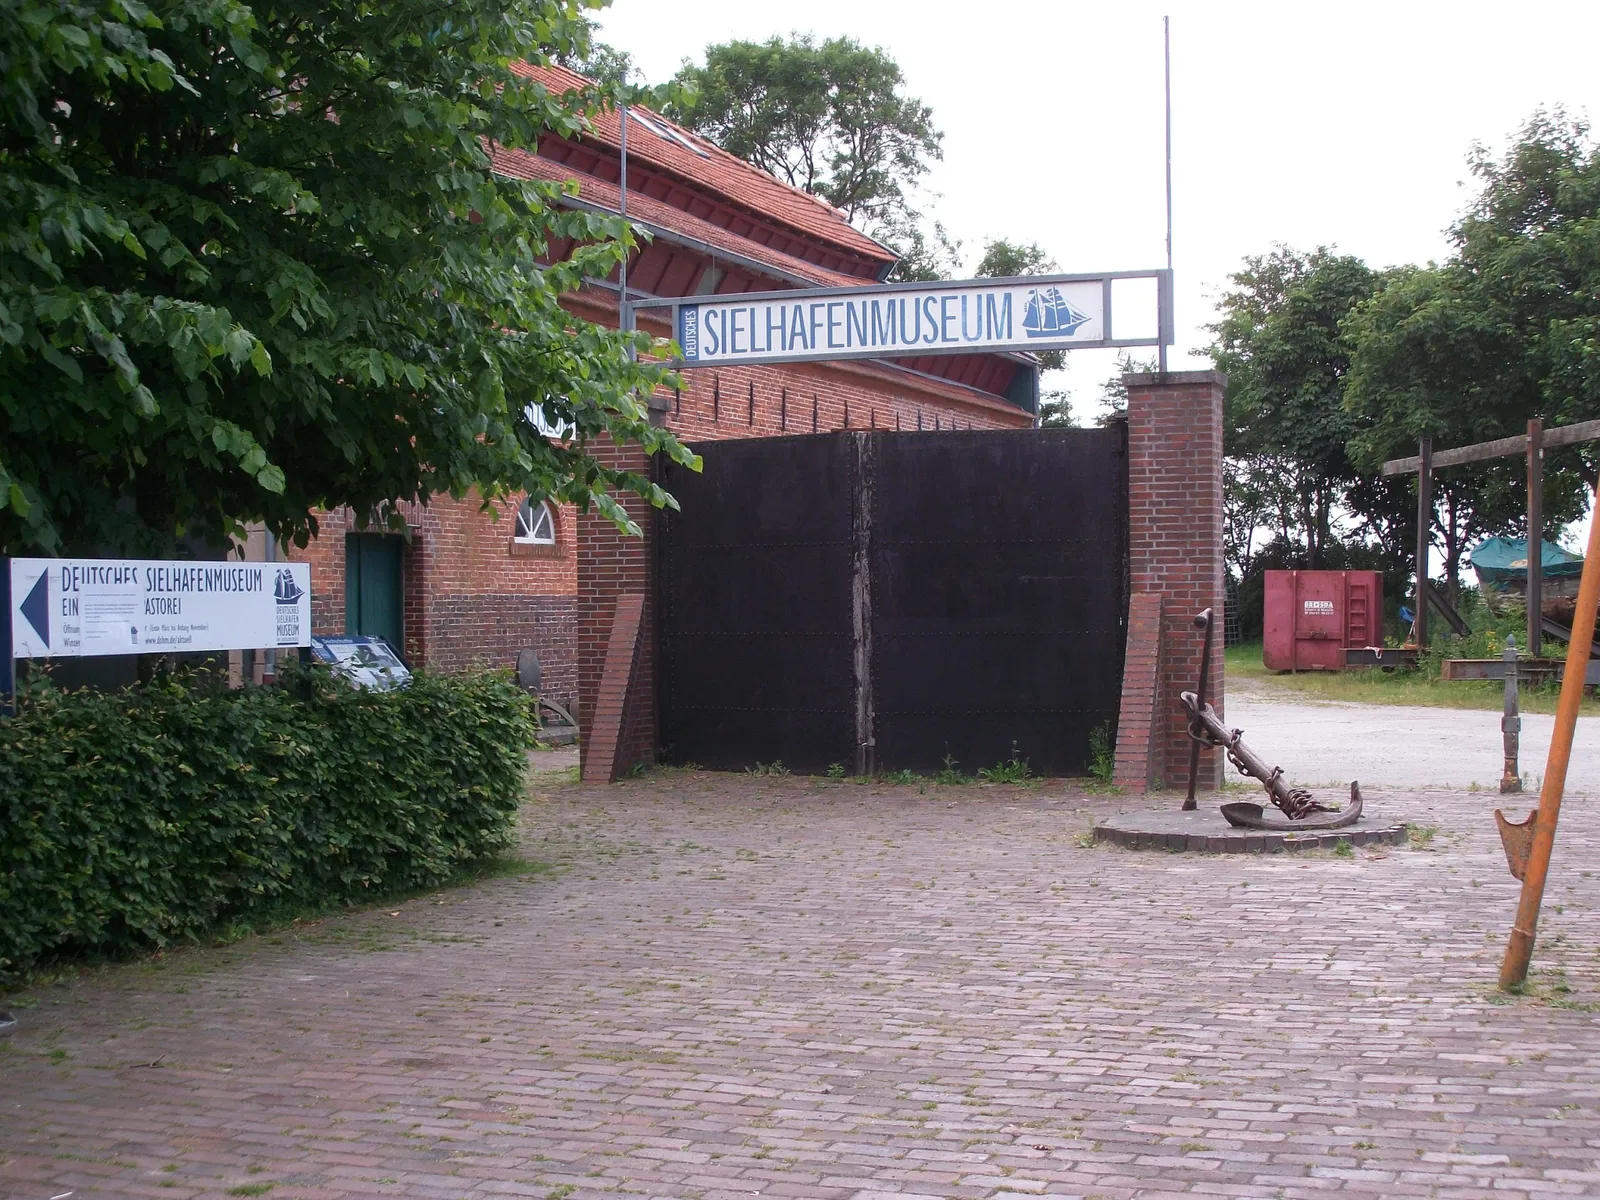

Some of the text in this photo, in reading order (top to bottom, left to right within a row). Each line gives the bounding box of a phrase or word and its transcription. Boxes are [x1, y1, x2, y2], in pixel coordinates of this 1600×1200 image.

[685, 310, 697, 357] DEUTSCHES
[704, 292, 1013, 356] SIELHAFENMUSEUM
[146, 567, 262, 592] SIELHAFENMUSEUM
[144, 597, 182, 615] ASTOREI
[276, 624, 300, 636] MUSEUM
